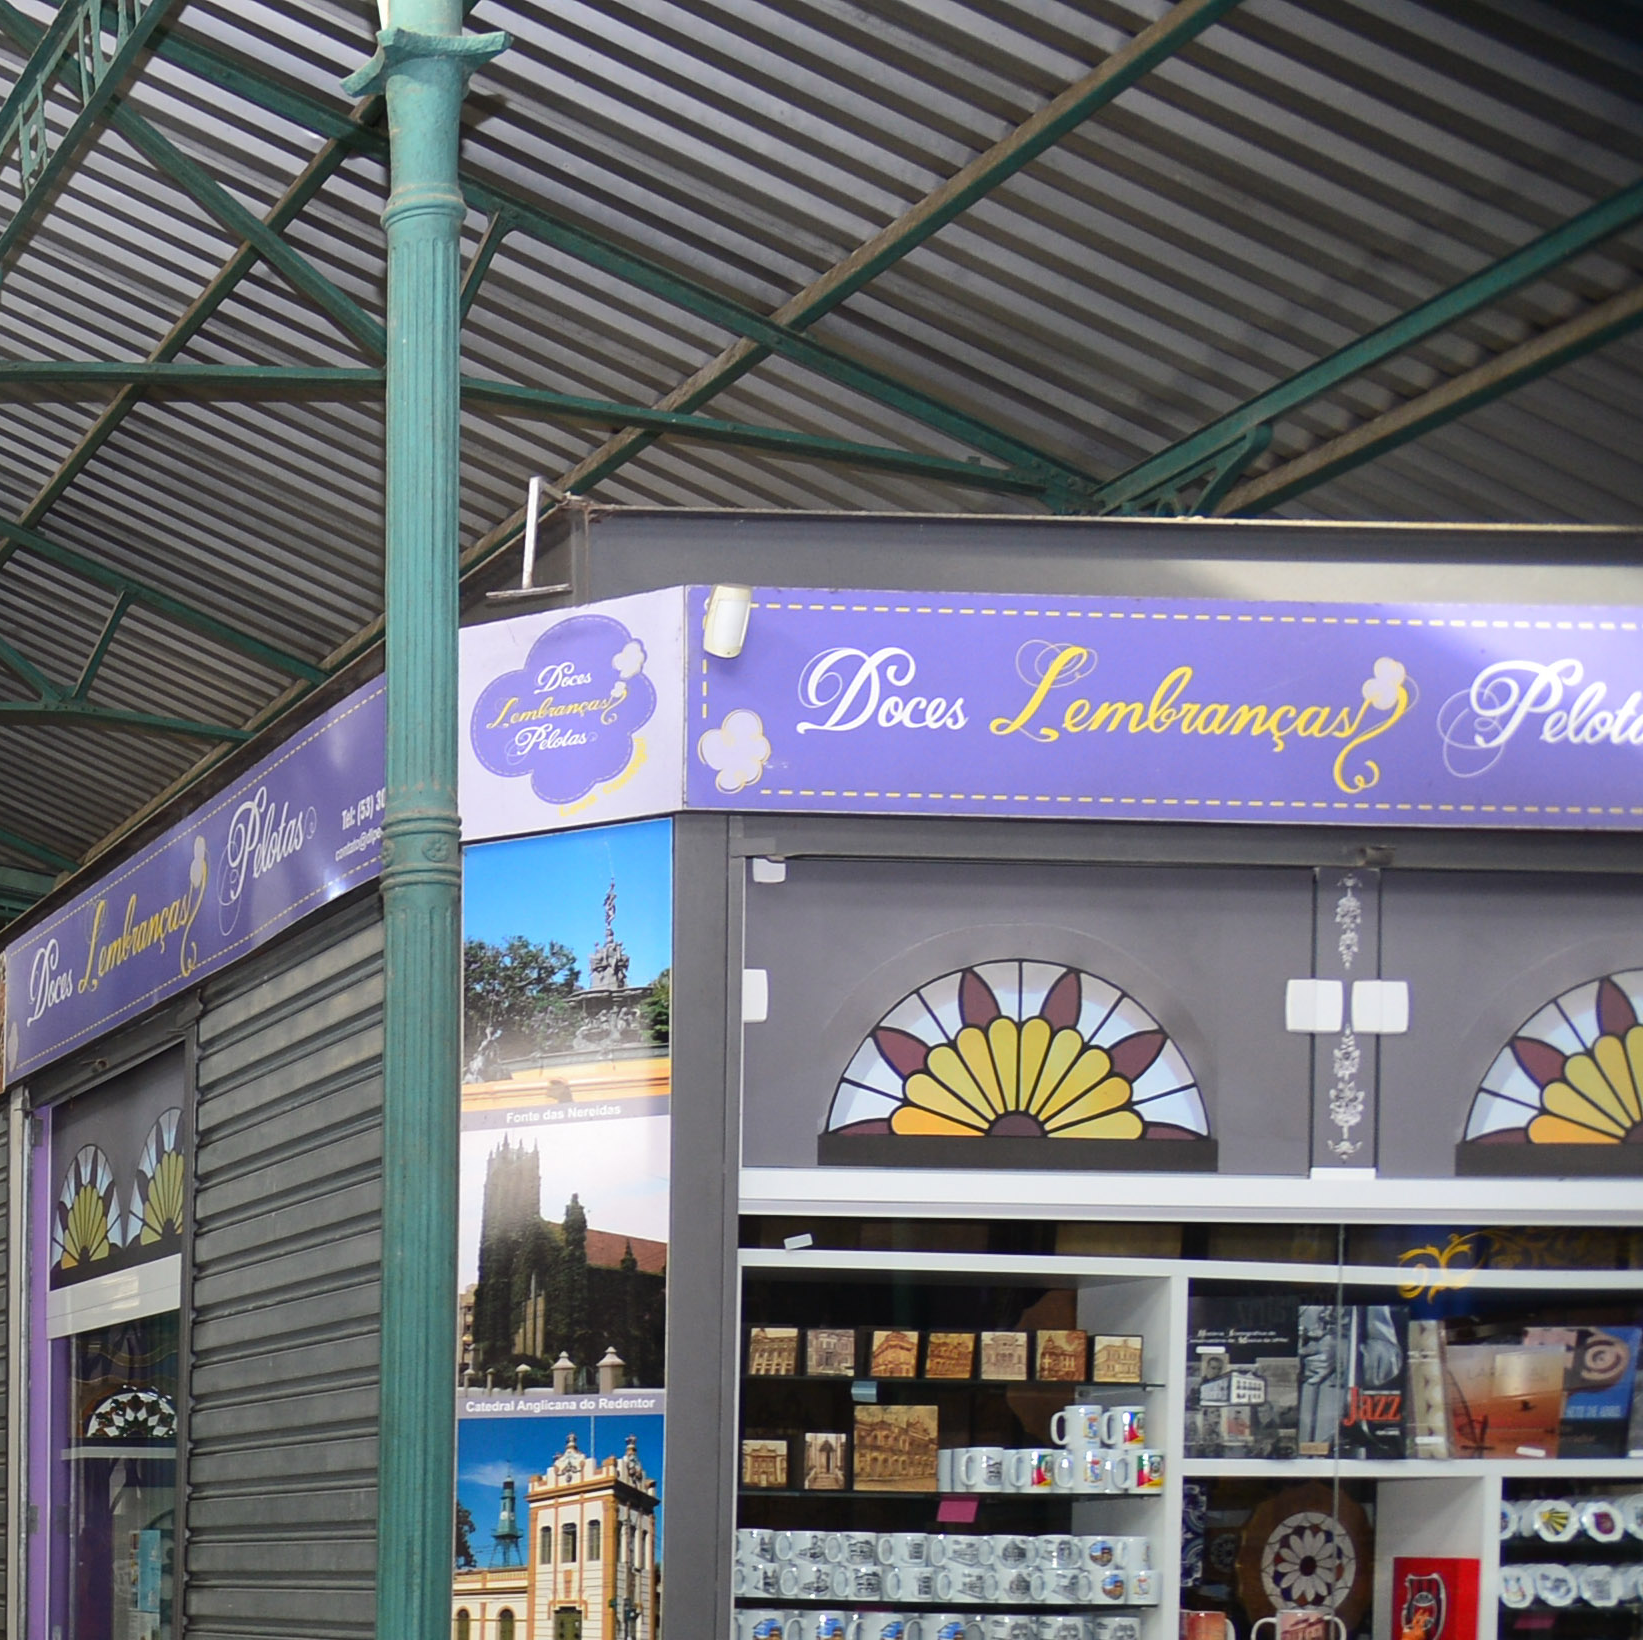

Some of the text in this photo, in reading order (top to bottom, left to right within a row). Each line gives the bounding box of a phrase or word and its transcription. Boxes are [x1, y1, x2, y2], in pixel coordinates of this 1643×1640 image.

[533, 661, 592, 695] Doces
[486, 690, 627, 729] Lembranças
[796, 646, 969, 734] Doces
[990, 640, 1407, 793] Lembranças
[513, 723, 589, 756] Pelotas
[27, 786, 306, 1027] Doces Lembranças Pelotas
[506, 1111, 540, 1124] Fonte
[543, 1109, 564, 1121] das
[466, 1398, 656, 1413] Catedral Anglicana do Redentor
[1343, 1386, 1402, 1426] Jazz
